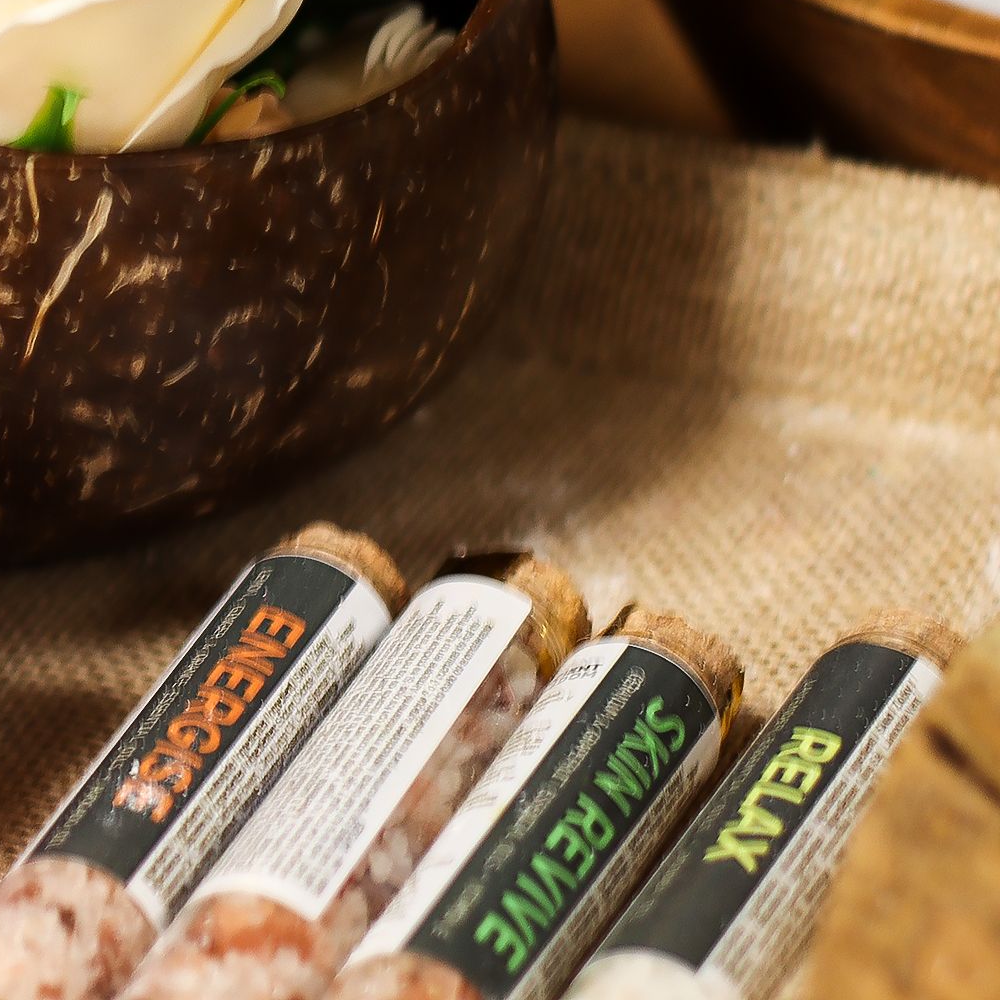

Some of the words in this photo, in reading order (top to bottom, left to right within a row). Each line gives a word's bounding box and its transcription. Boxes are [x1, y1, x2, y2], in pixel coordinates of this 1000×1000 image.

[113, 607, 306, 823] ENERGISE
[593, 697, 687, 814] SKIN
[703, 726, 842, 874] RELAX
[475, 792, 615, 974] REVIVE
